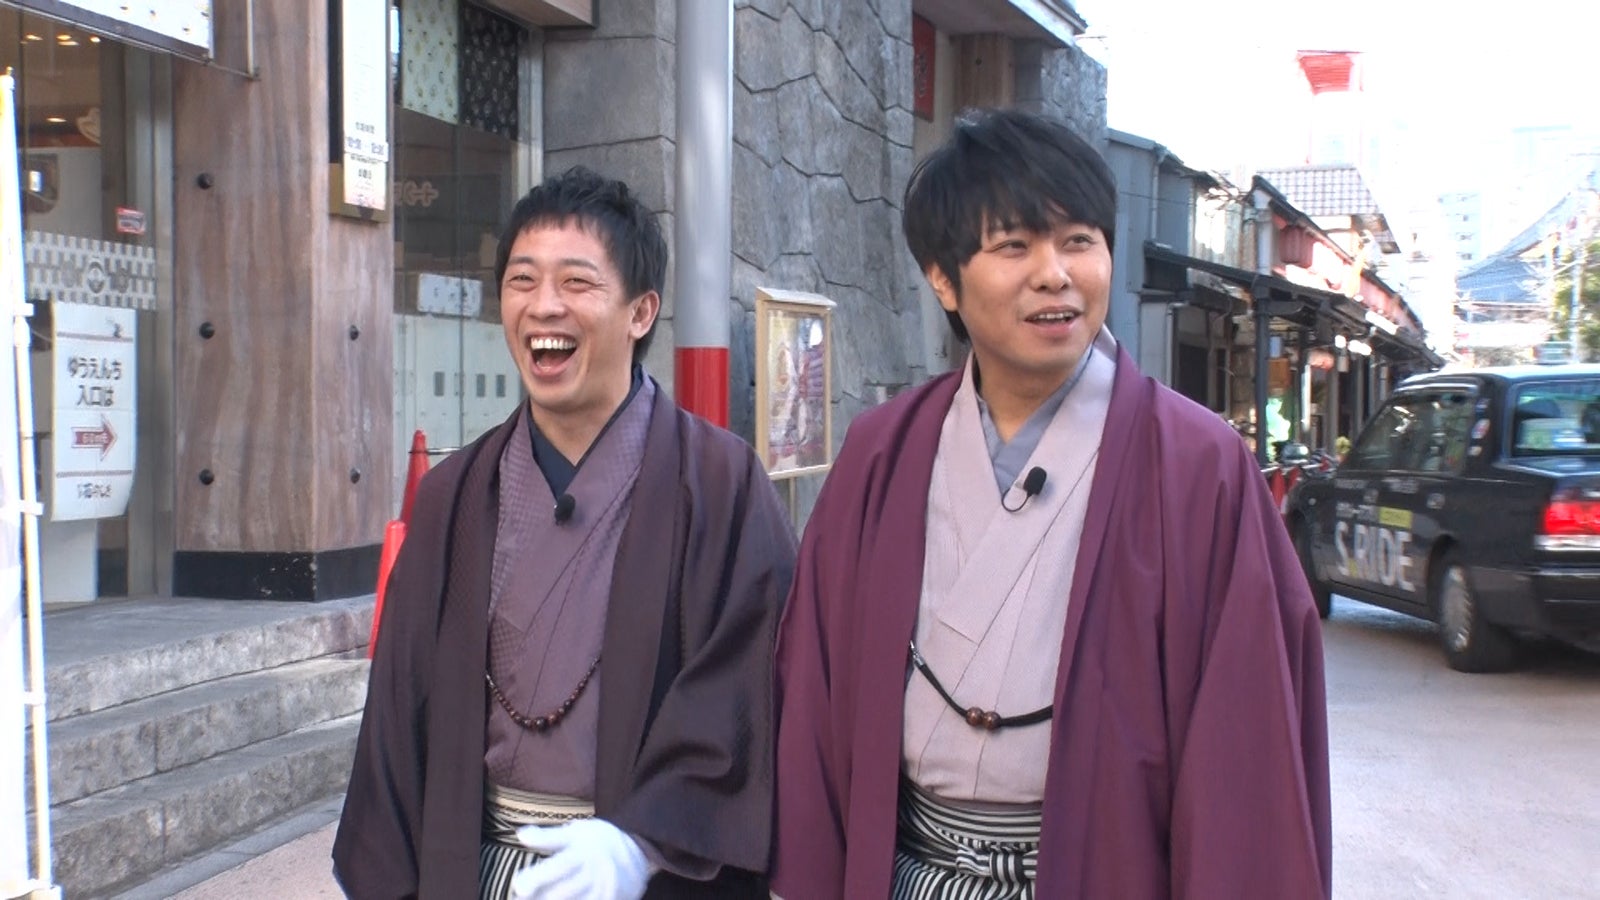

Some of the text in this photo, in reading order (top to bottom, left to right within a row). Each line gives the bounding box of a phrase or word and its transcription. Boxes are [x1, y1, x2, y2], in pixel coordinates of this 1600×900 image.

[67, 357, 122, 380] ゆうえんち
[76, 385, 114, 407] 入口は
[1335, 521, 1416, 592] S.RIDE
